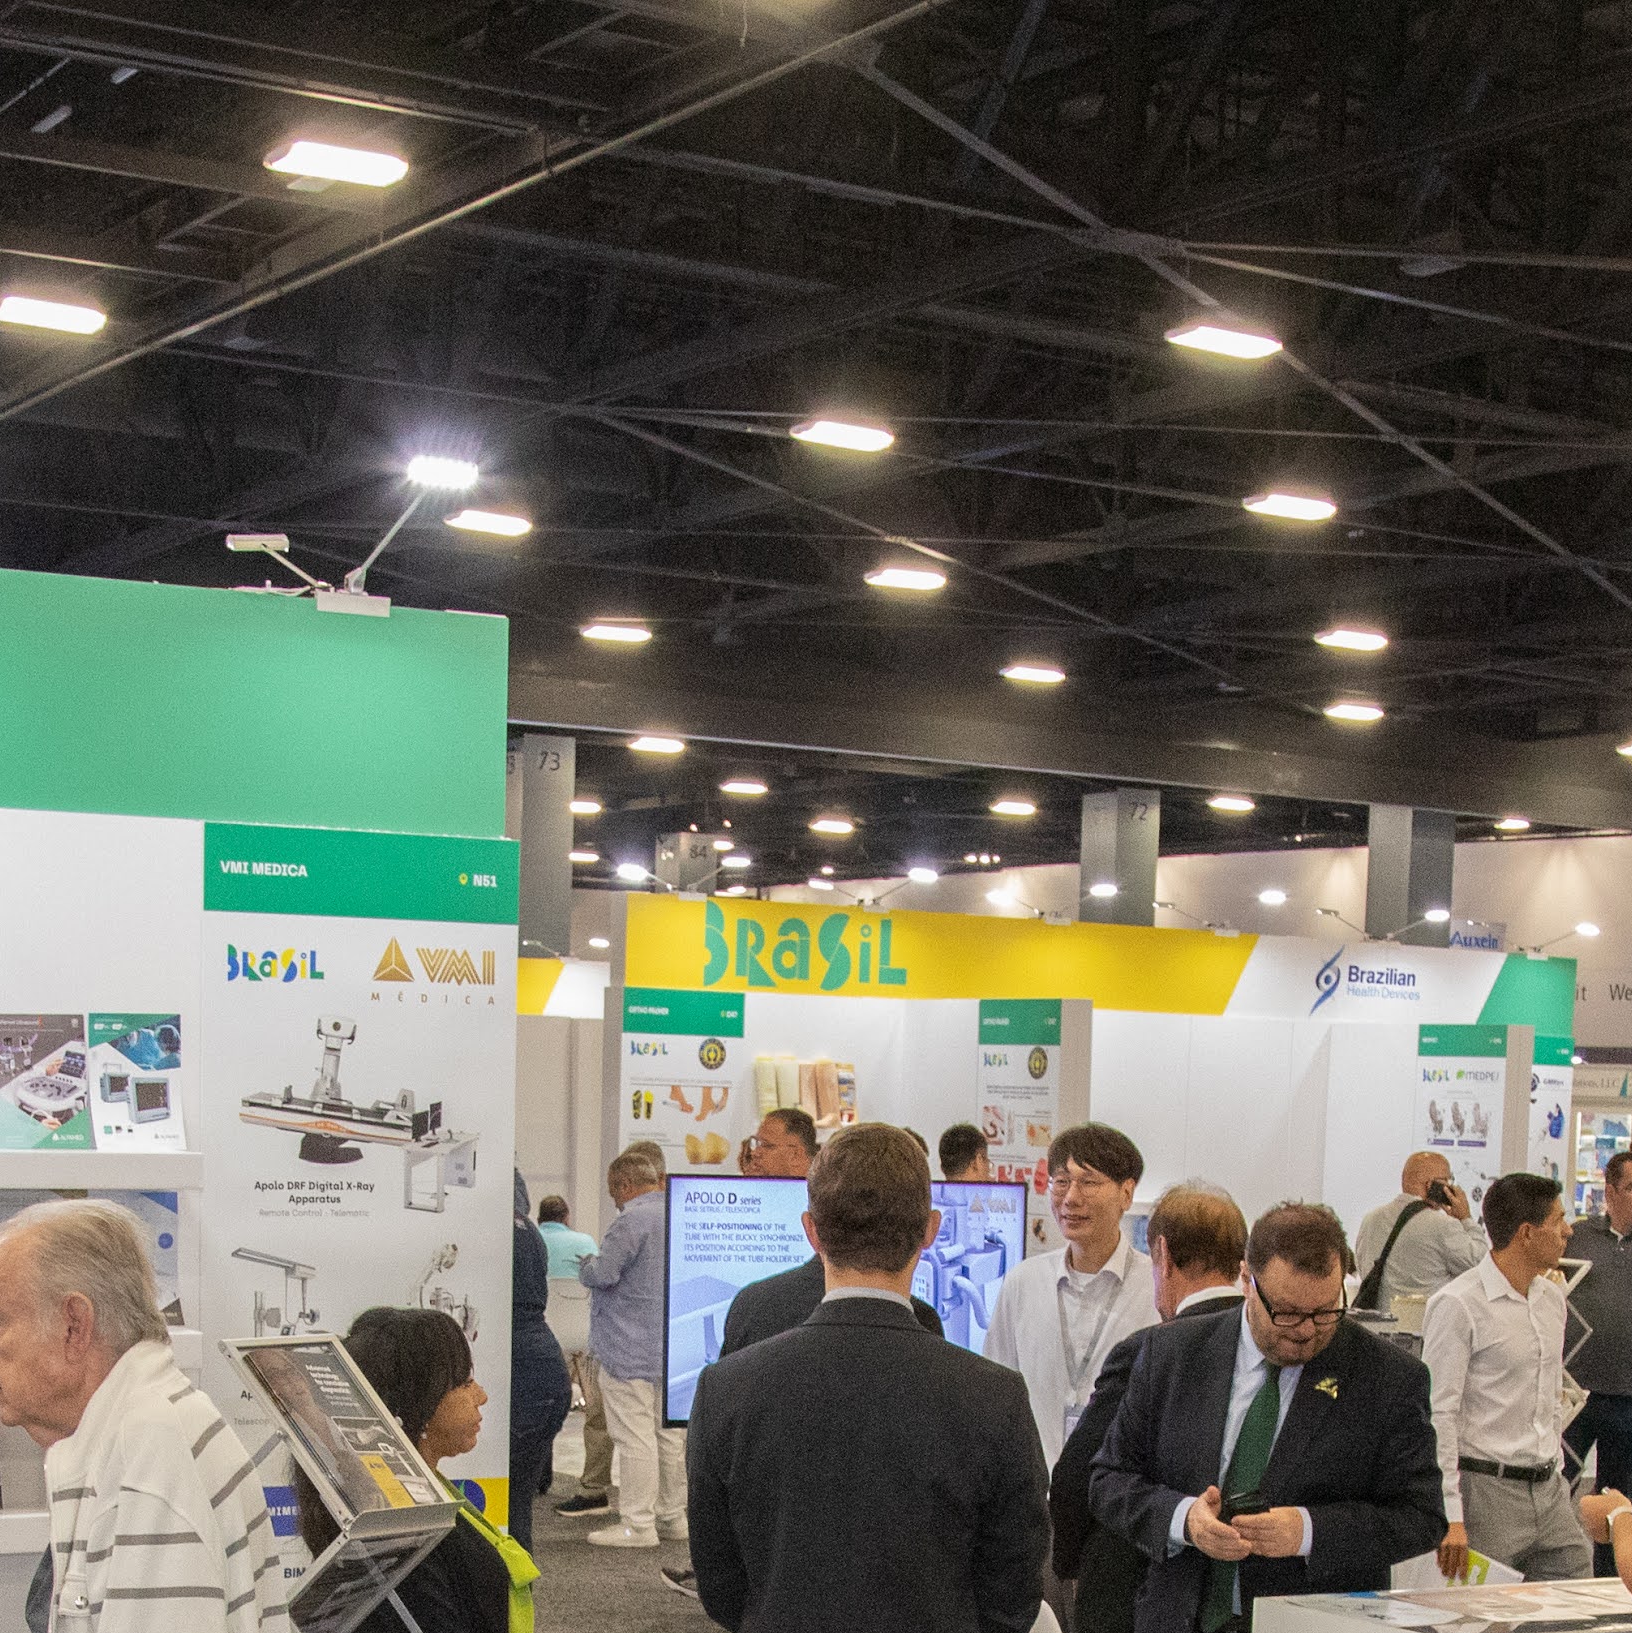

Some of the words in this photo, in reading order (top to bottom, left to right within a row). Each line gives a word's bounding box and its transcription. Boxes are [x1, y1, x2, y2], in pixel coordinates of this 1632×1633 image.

[538, 752, 561, 771] 73
[220, 860, 249, 875] VMI
[252, 861, 308, 878] MEDICA
[472, 873, 498, 888] N51
[415, 948, 496, 987] VMI
[1348, 965, 1416, 987] Brazilian
[370, 991, 496, 1006] MÉDICA
[1346, 985, 1380, 998] Health
[1380, 987, 1421, 1000] Devices
[254, 1181, 285, 1192] Apolo
[287, 1181, 306, 1191] DRF
[308, 1181, 344, 1193] Digital
[346, 1181, 375, 1193] X-Ray
[288, 1194, 341, 1205] Apparatus
[684, 1190, 725, 1205] APOLO
[727, 1192, 737, 1204] D
[740, 1195, 762, 1206] series
[685, 1222, 698, 1230] THE
[699, 1222, 763, 1231] SELF-POSITIONING
[763, 1223, 773, 1231] OF
[775, 1223, 786, 1231] THE
[695, 1243, 725, 1251] POSITION
[727, 1244, 765, 1252] ACCORDING
[767, 1244, 776, 1252] TO
[777, 1244, 790, 1252] THE
